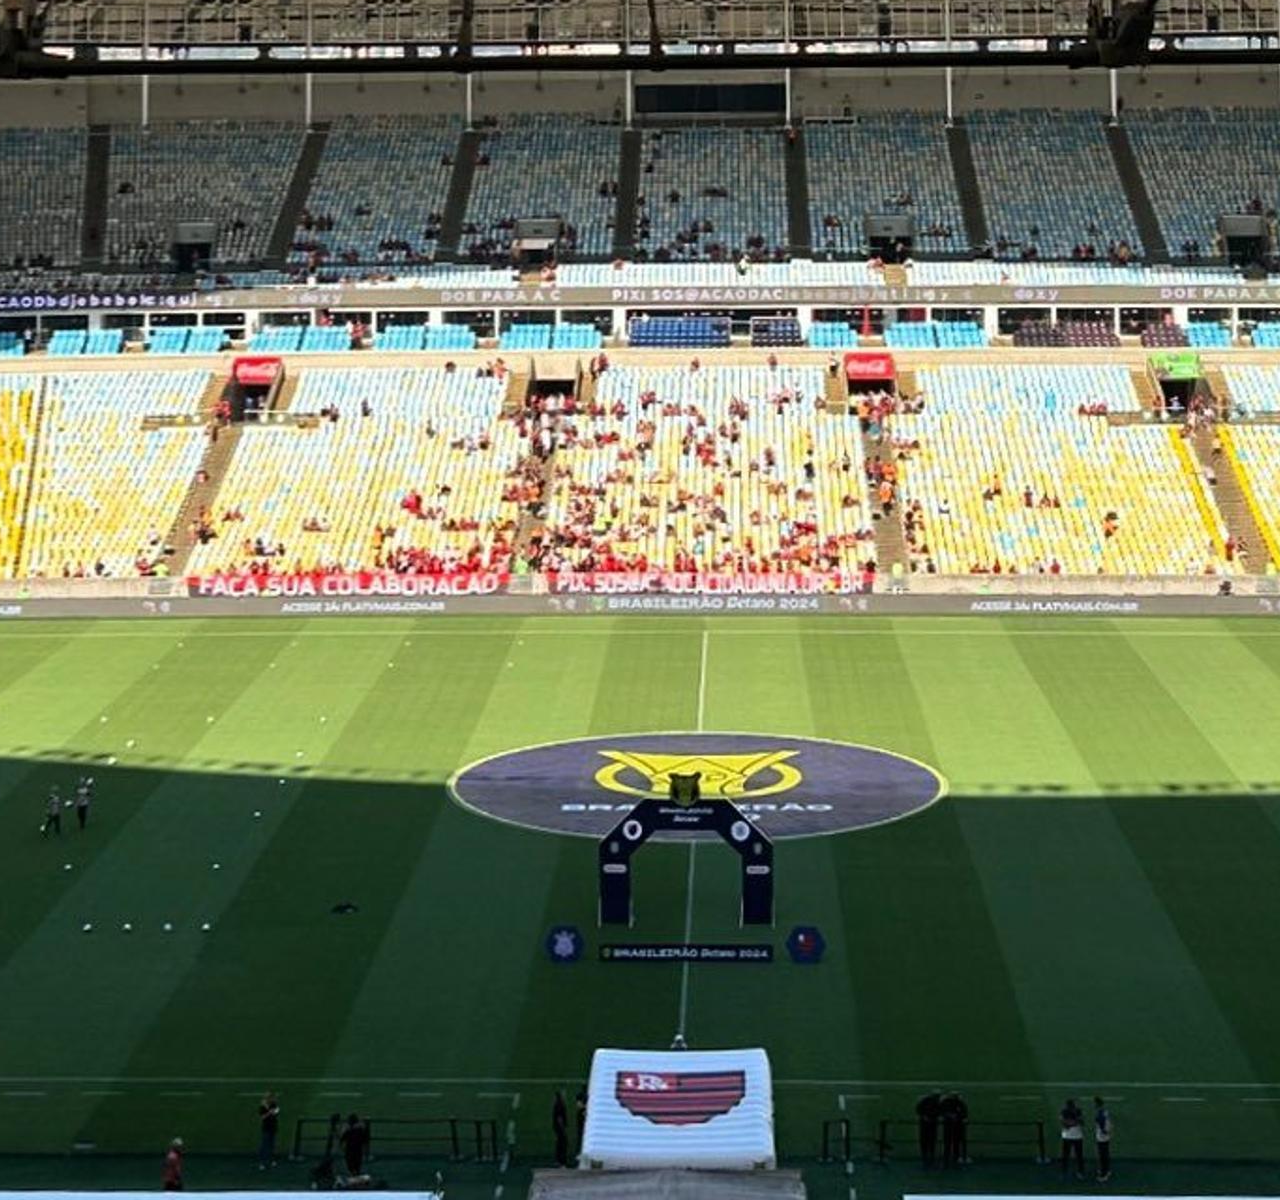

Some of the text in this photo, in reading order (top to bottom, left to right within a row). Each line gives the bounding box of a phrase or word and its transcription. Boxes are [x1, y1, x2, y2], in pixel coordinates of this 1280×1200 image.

[441, 289, 562, 302] DOE PARA A C
[1160, 288, 1197, 300] DOE
[1203, 288, 1253, 300] PARA
[1257, 288, 1269, 299] A
[262, 575, 316, 597] SUA
[608, 597, 723, 610] BRASILEIRÃO
[779, 599, 819, 610] 2024
[613, 947, 698, 958] BRASILEIRÃO
[739, 949, 768, 959] 2024
